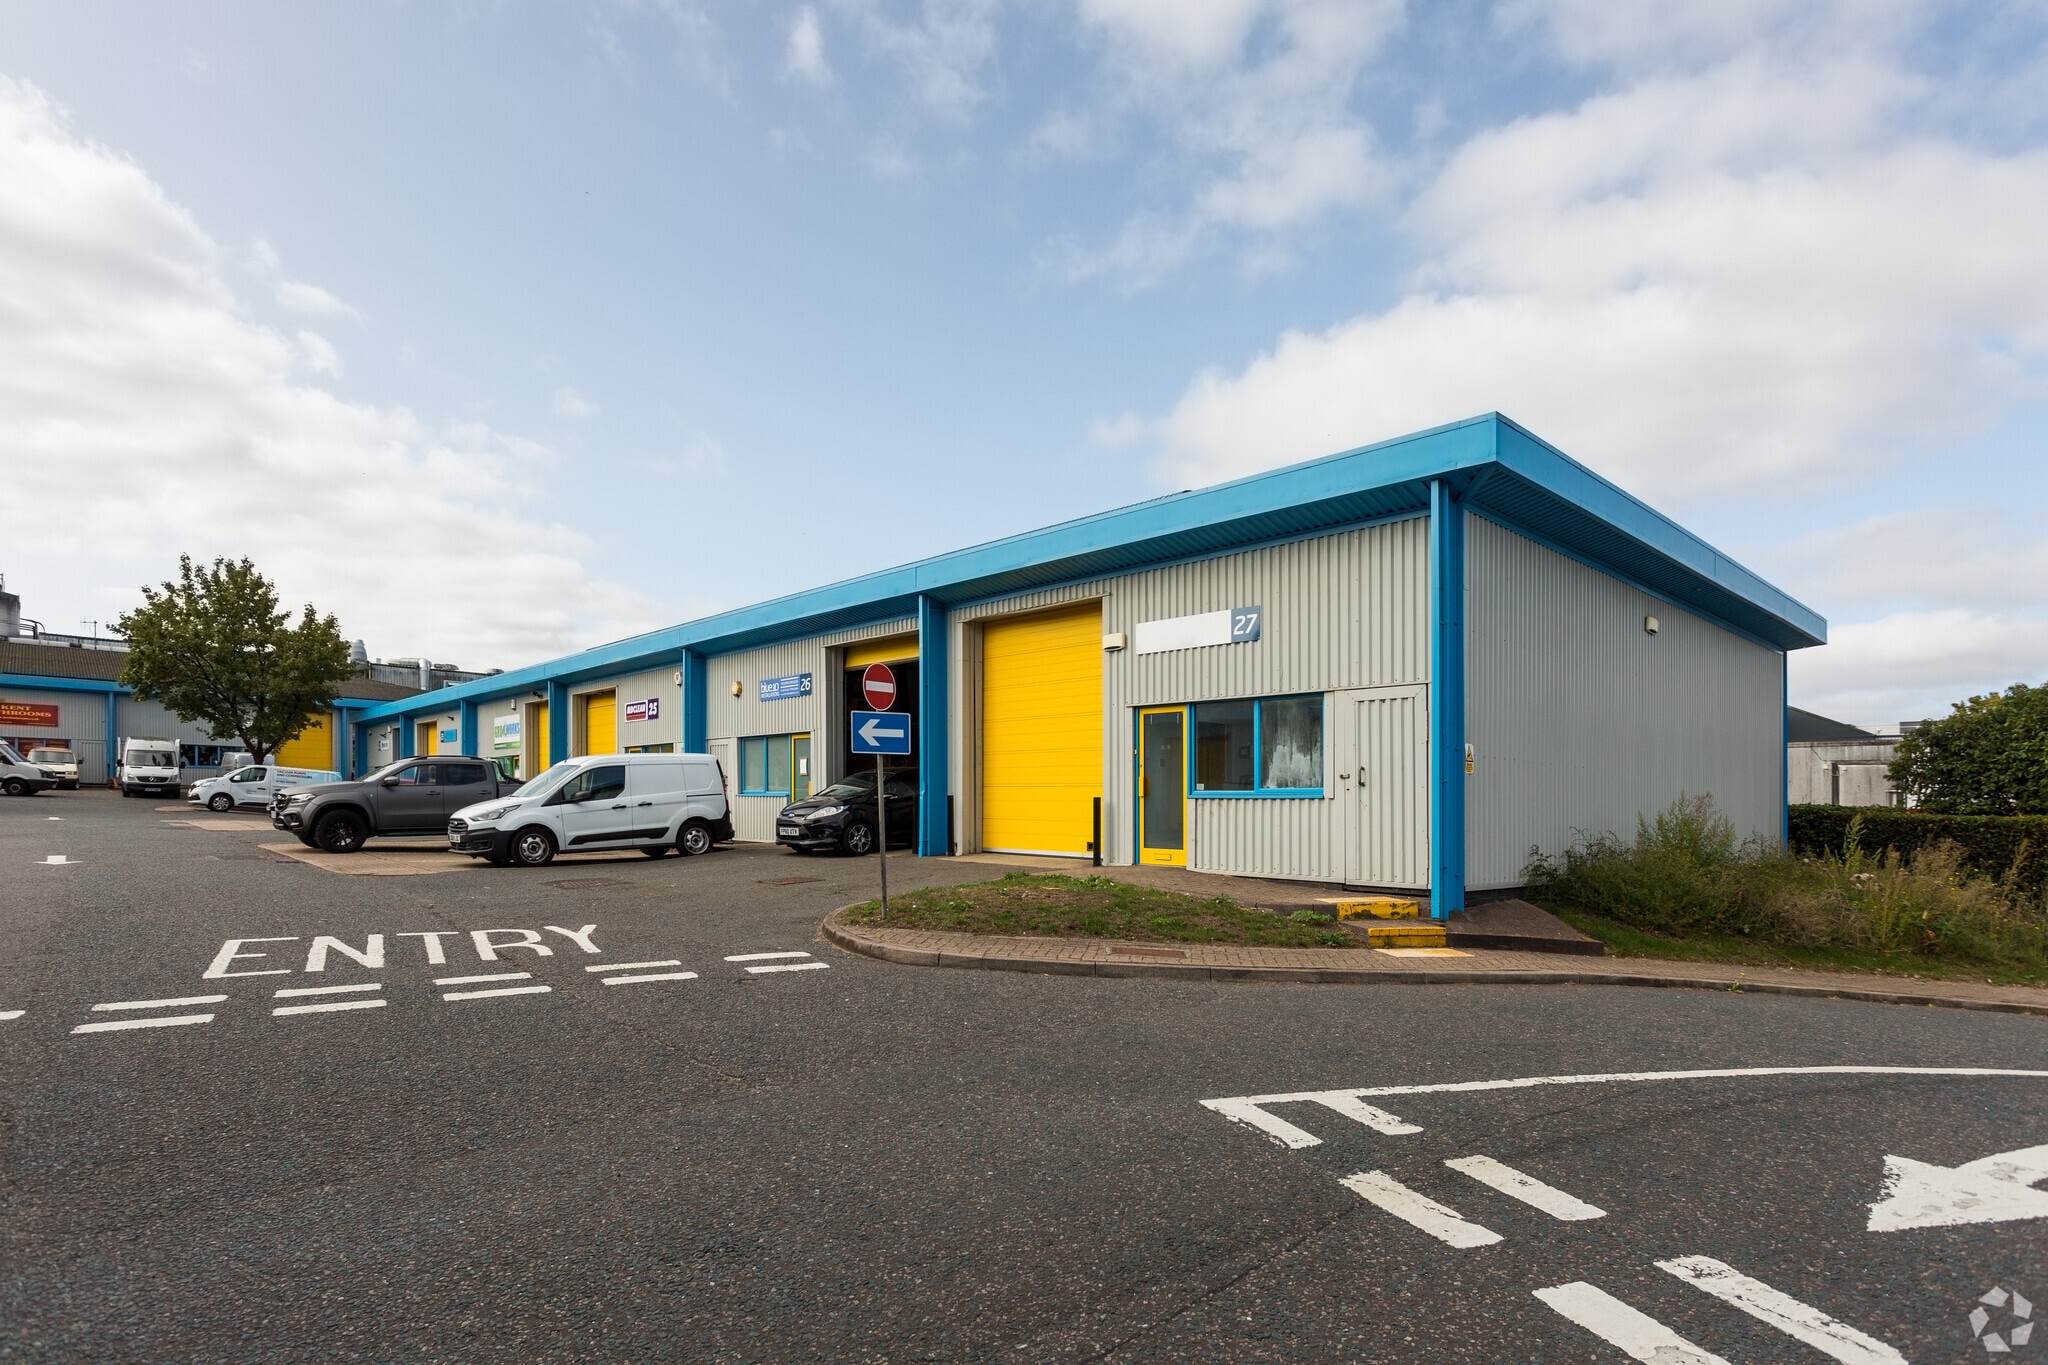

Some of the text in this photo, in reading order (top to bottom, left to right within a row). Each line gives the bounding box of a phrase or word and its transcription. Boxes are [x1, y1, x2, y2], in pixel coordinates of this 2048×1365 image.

[1233, 613, 1258, 635] 27
[800, 677, 811, 691] 26
[648, 702, 657, 715] 25
[202, 924, 601, 979] ENTRY
